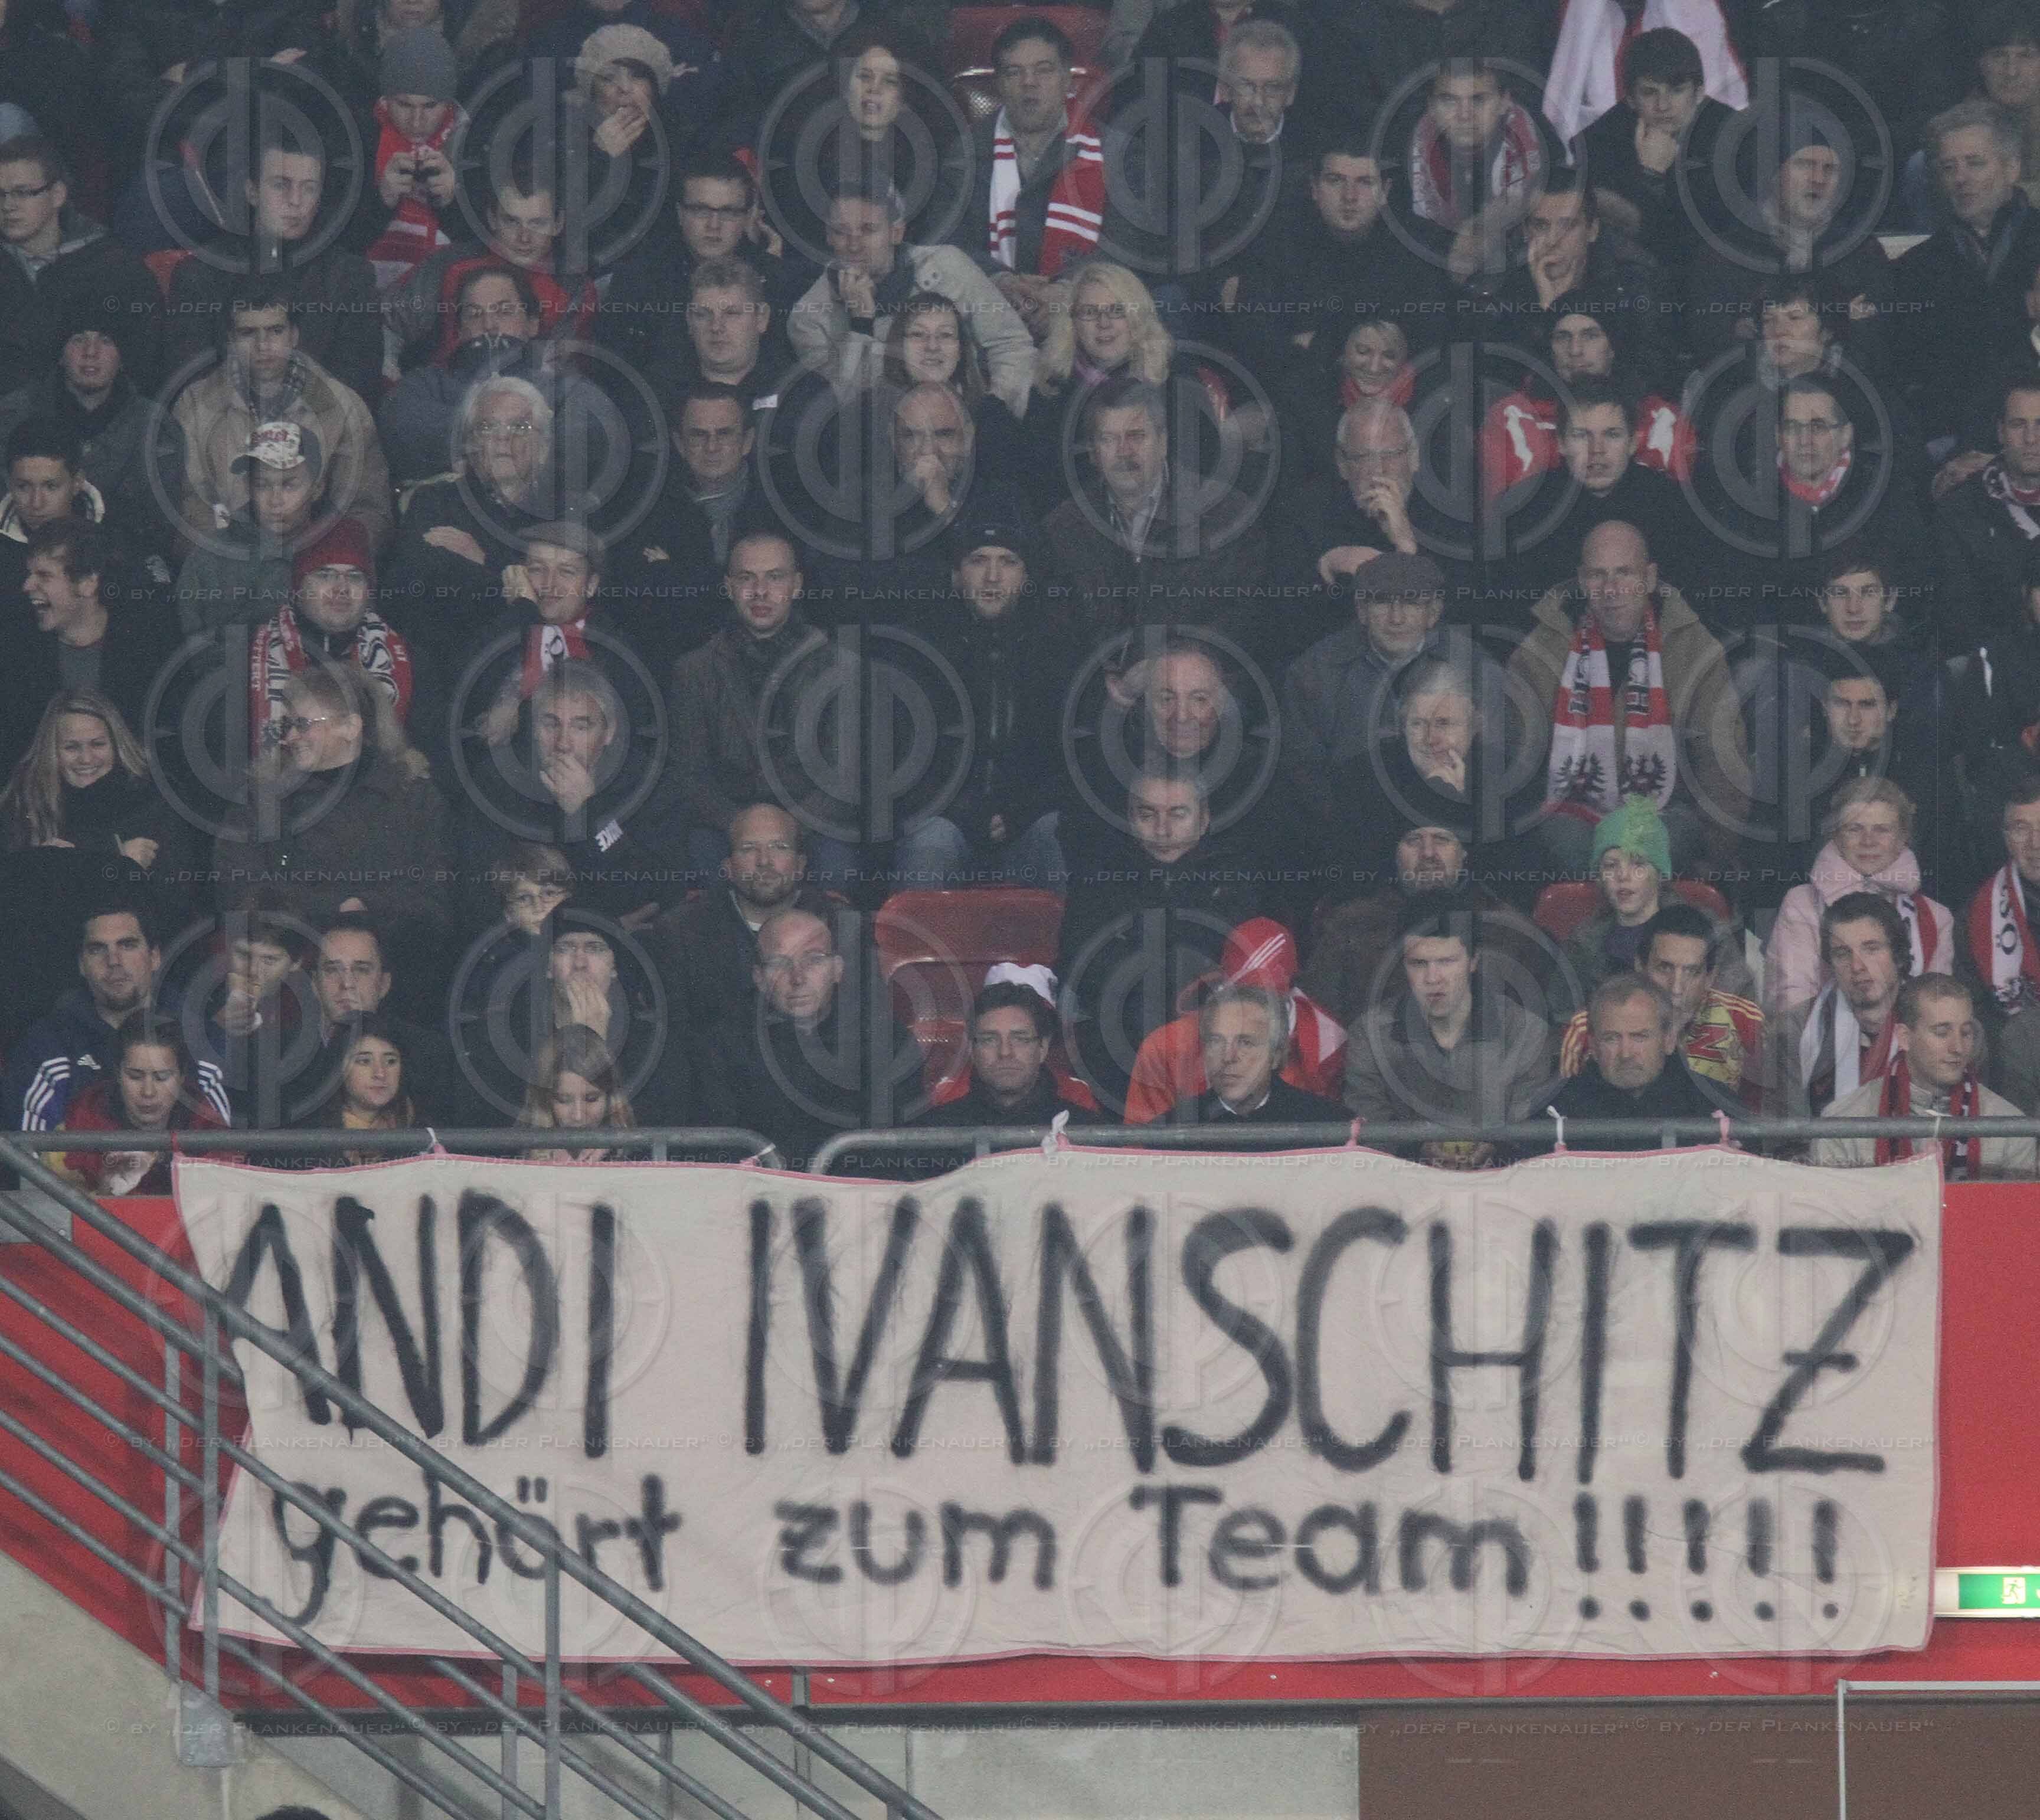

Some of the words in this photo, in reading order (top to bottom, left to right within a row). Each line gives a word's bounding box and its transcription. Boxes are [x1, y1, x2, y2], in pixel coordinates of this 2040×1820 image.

[223, 1186, 616, 1459] ANDI
[744, 1194, 1916, 1484] IVANSCHITZ
[270, 1468, 684, 1627] gehört
[773, 1499, 1058, 1591] zum
